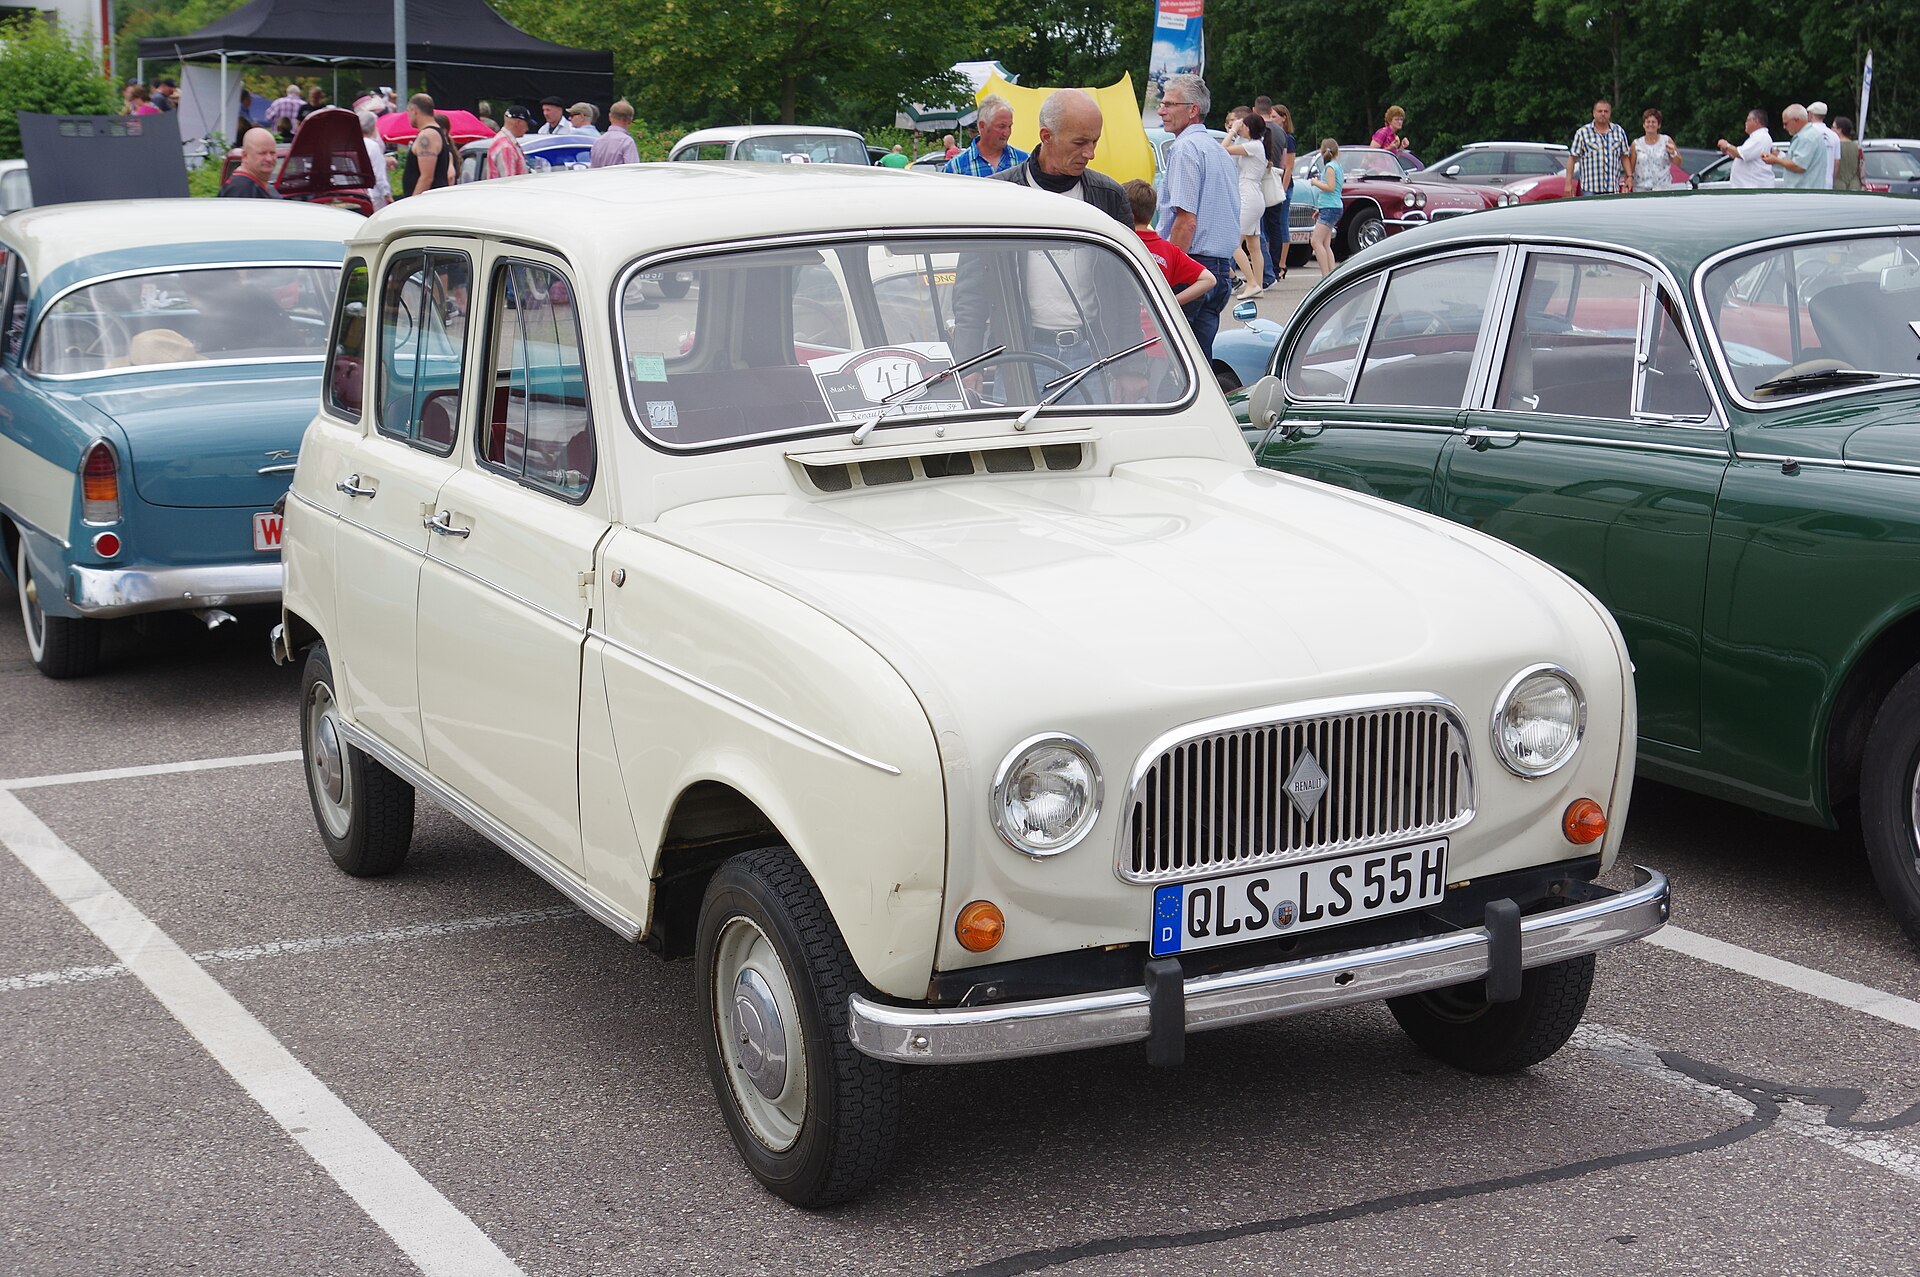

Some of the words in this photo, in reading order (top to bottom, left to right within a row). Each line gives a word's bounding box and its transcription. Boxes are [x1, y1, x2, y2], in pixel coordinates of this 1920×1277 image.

[877, 362, 913, 394] 47
[829, 385, 846, 394] Start
[848, 383, 858, 391] Nr.
[1294, 777, 1322, 792] RENAULT
[1187, 879, 1270, 939] QLS
[1299, 865, 1353, 923] LS
[1363, 846, 1446, 910] 55H
[1161, 926, 1173, 943] D
